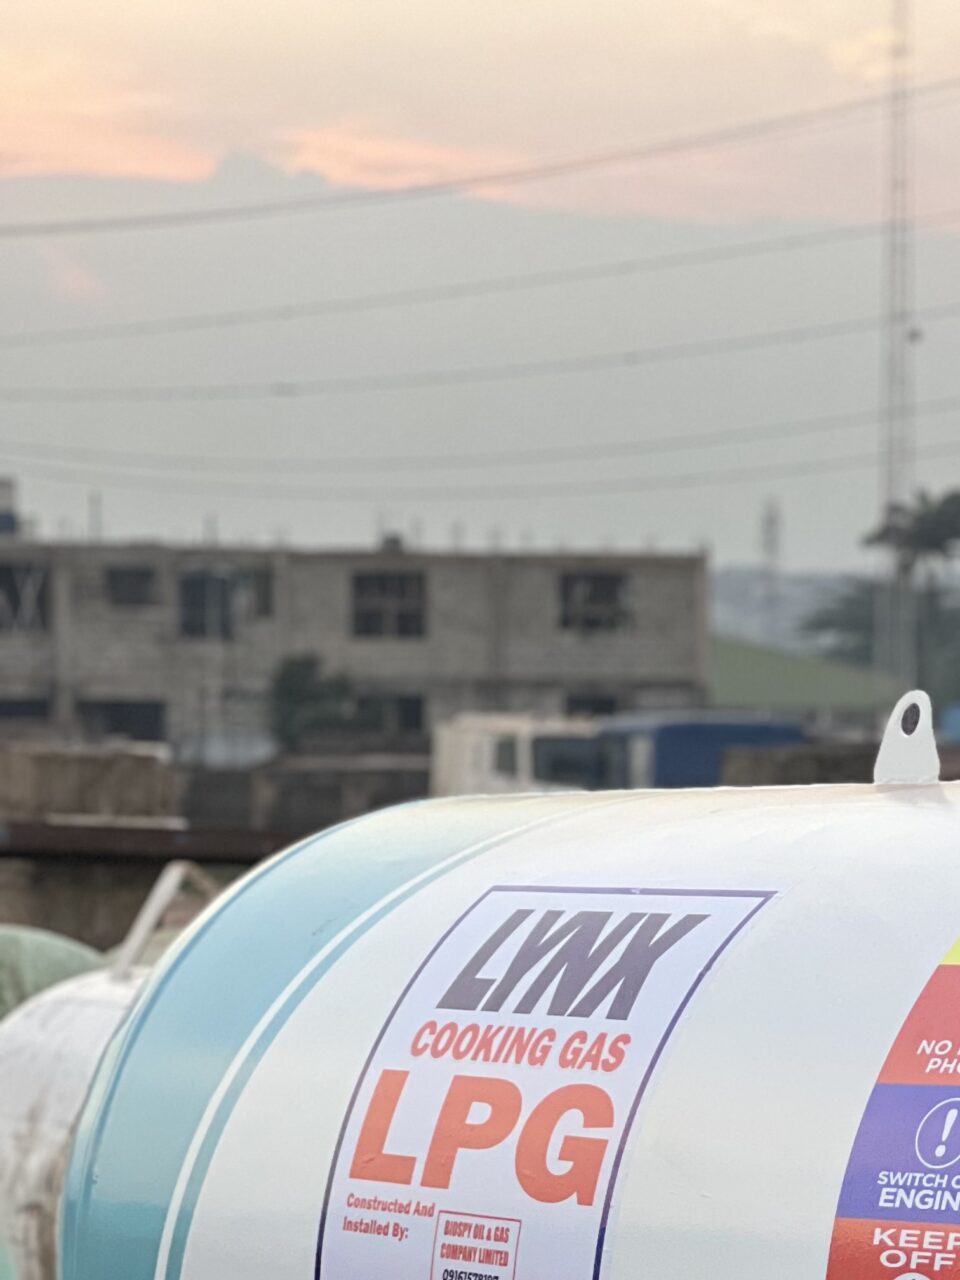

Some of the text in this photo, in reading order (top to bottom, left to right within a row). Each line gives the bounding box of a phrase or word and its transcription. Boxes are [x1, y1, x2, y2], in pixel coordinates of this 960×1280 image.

[435, 908, 711, 1021] LYNX
[410, 1019, 632, 1073] COOKING GAS
[916, 1039, 953, 1056] NO
[348, 1068, 615, 1206] LPG
[877, 1171, 949, 1188] SWITCH
[346, 1193, 436, 1218] Constructed And
[342, 1216, 409, 1242] Installed By:
[473, 1223, 485, 1240] OIL
[486, 1227, 492, 1242] &
[494, 1226, 510, 1243] GAS
[440, 1243, 510, 1267] COMPANY LIMITED
[879, 1249, 957, 1271] OFF
